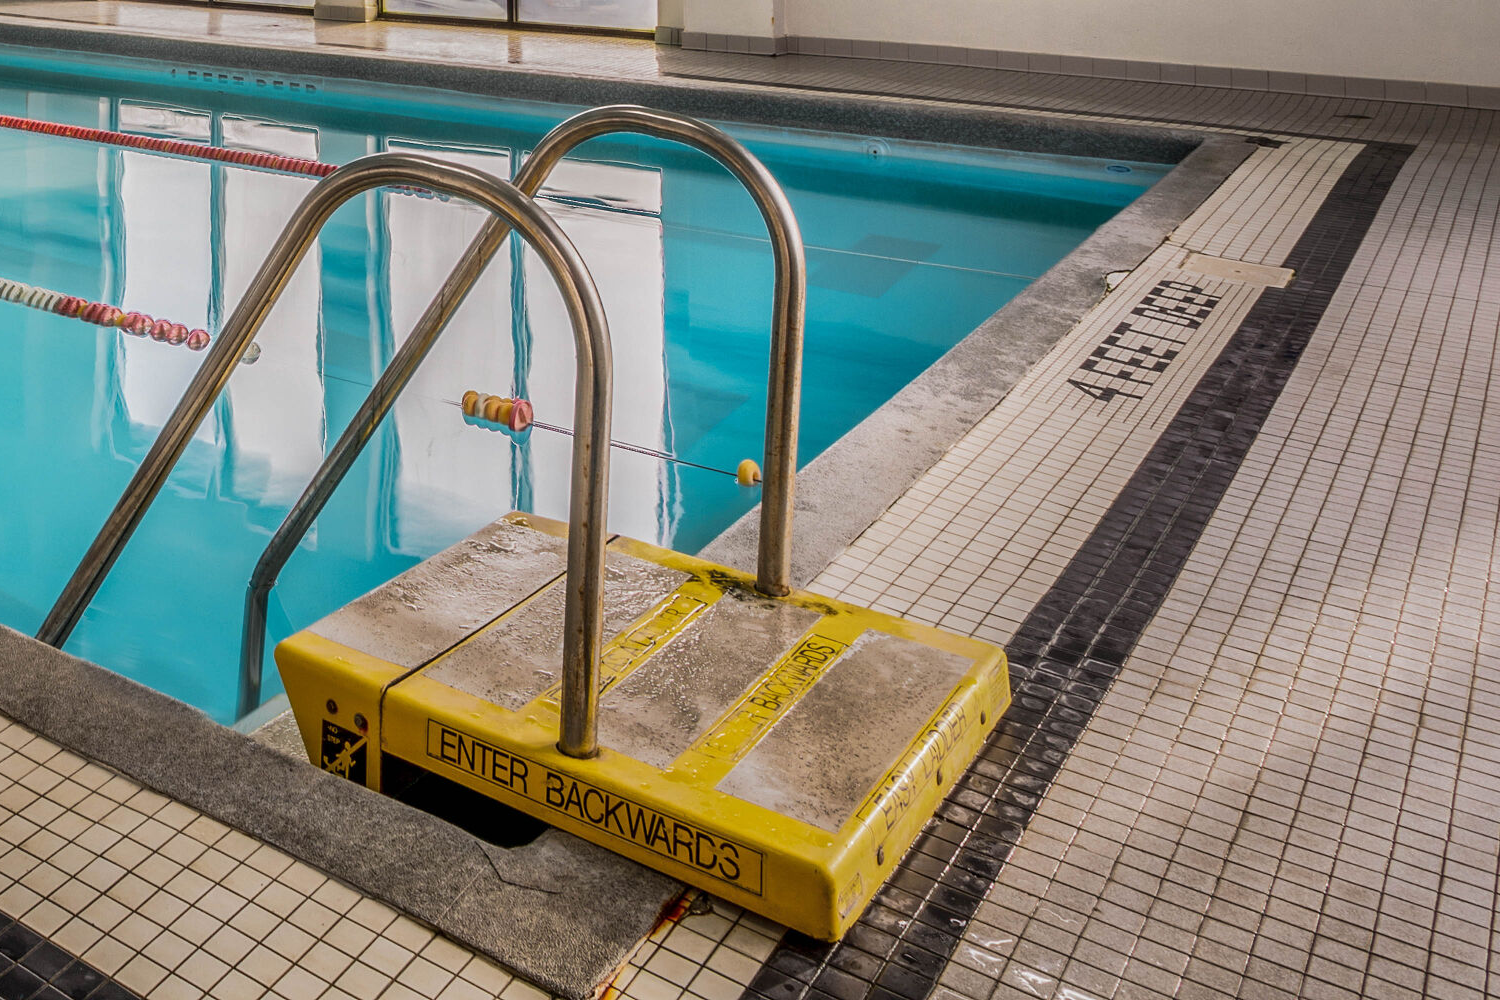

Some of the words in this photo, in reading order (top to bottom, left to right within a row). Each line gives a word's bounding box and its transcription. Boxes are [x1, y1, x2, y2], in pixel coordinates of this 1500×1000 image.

[1130, 280, 1222, 330] DEEP
[1079, 321, 1187, 386] FEET
[1066, 378, 1143, 403] 4
[750, 642, 836, 712] BACKWARDS
[440, 727, 529, 794] ENTER
[545, 771, 741, 881] BACKWARDS
